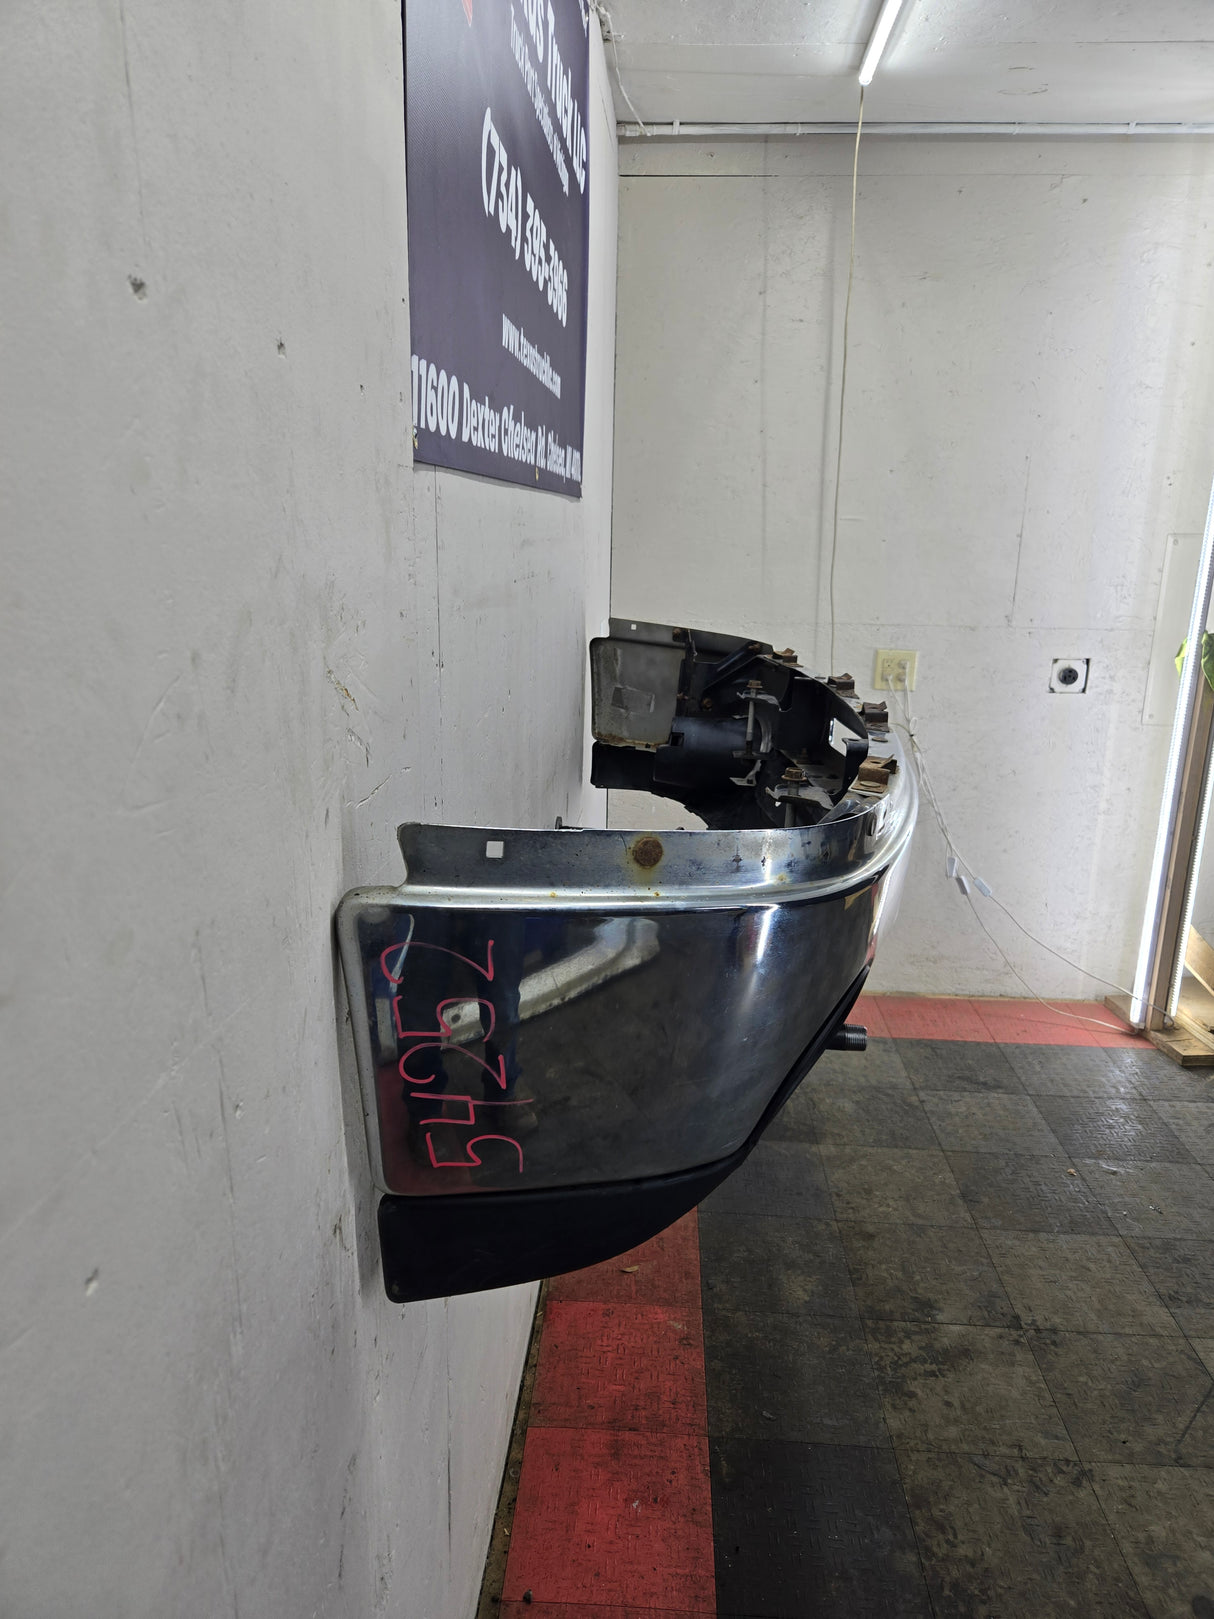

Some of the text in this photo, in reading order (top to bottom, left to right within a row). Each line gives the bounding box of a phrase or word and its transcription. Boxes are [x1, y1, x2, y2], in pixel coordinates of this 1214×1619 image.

[547, 0, 572, 158] Truck
[481, 106, 522, 260] (734)
[524, 192, 568, 328] 395-3966
[411, 354, 459, 440] 11600
[462, 382, 500, 454] Dexter
[501, 404, 536, 466] Chelsea
[380, 939, 534, 1174] 54252
